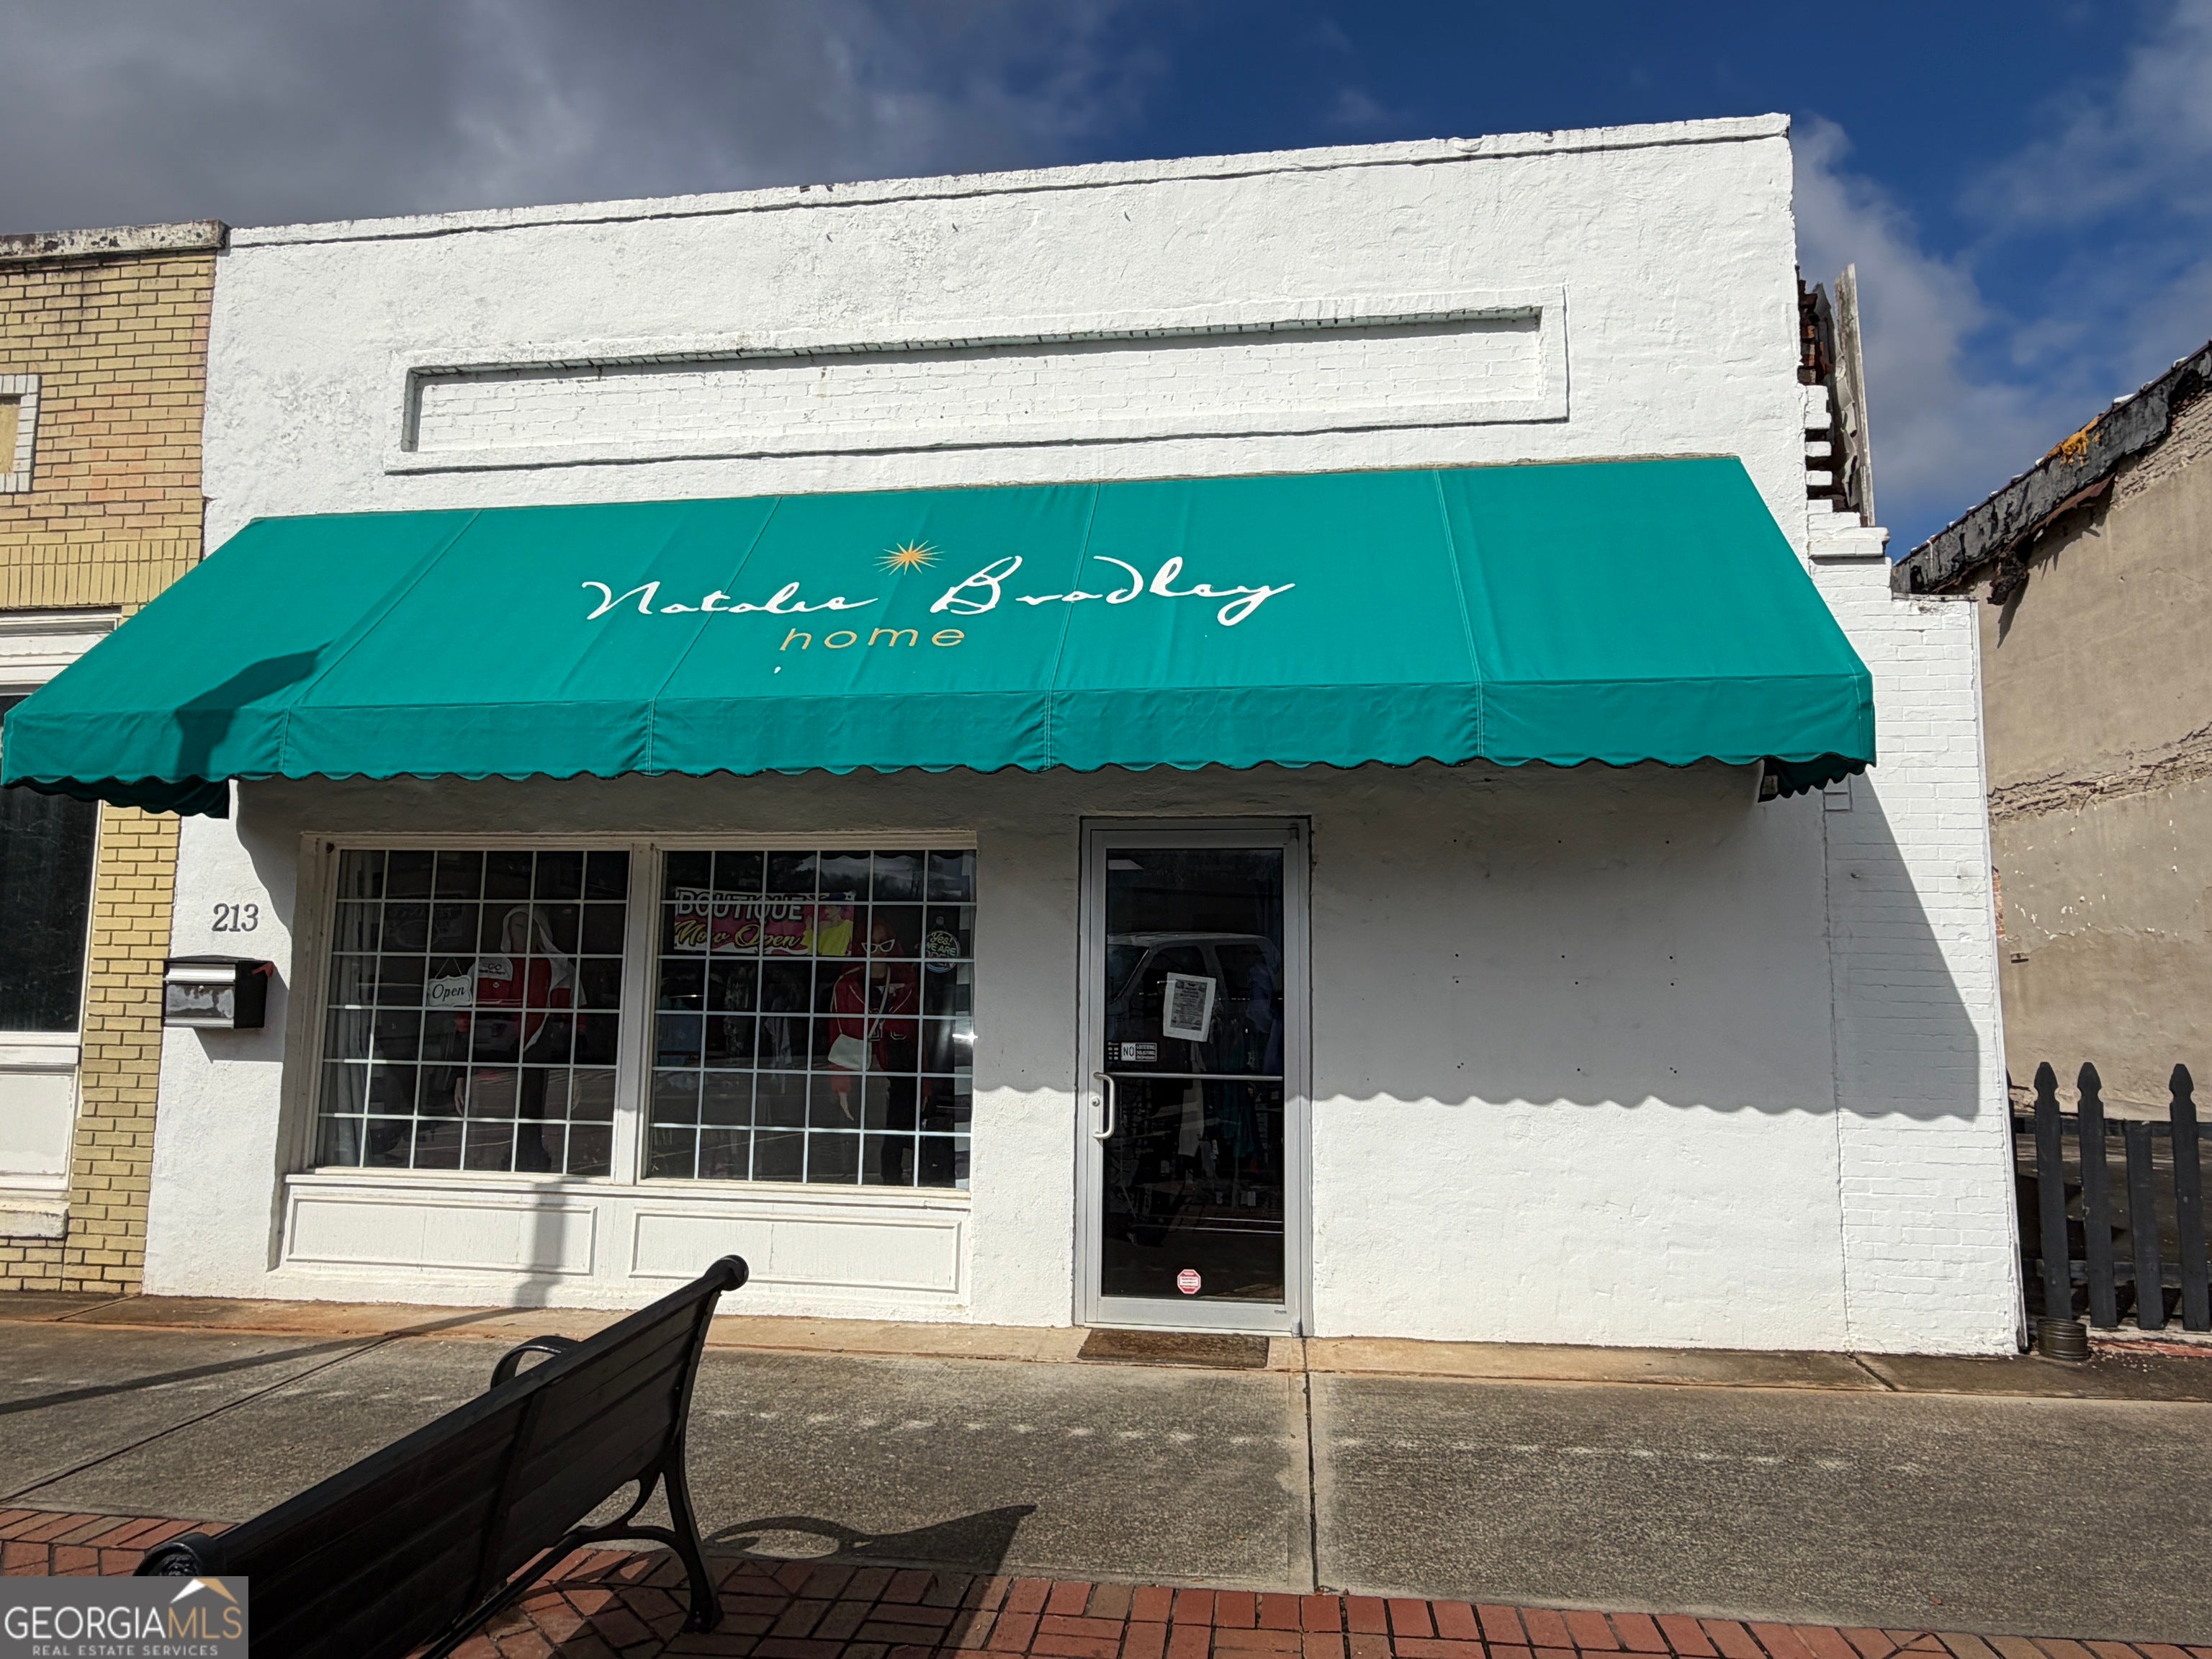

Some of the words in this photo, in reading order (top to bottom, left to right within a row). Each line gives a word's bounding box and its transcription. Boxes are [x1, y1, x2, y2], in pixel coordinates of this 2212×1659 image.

[930, 555, 1295, 627] Bradley
[781, 629, 966, 651] home
[678, 891, 804, 920] BOUTIQUE
[212, 903, 258, 932] 213
[675, 920, 730, 947] Now
[734, 923, 800, 951] Open
[930, 932, 953, 945] Yes!
[938, 945, 957, 956] ARE
[432, 984, 465, 1002] Open
[1123, 1046, 1135, 1057] NO
